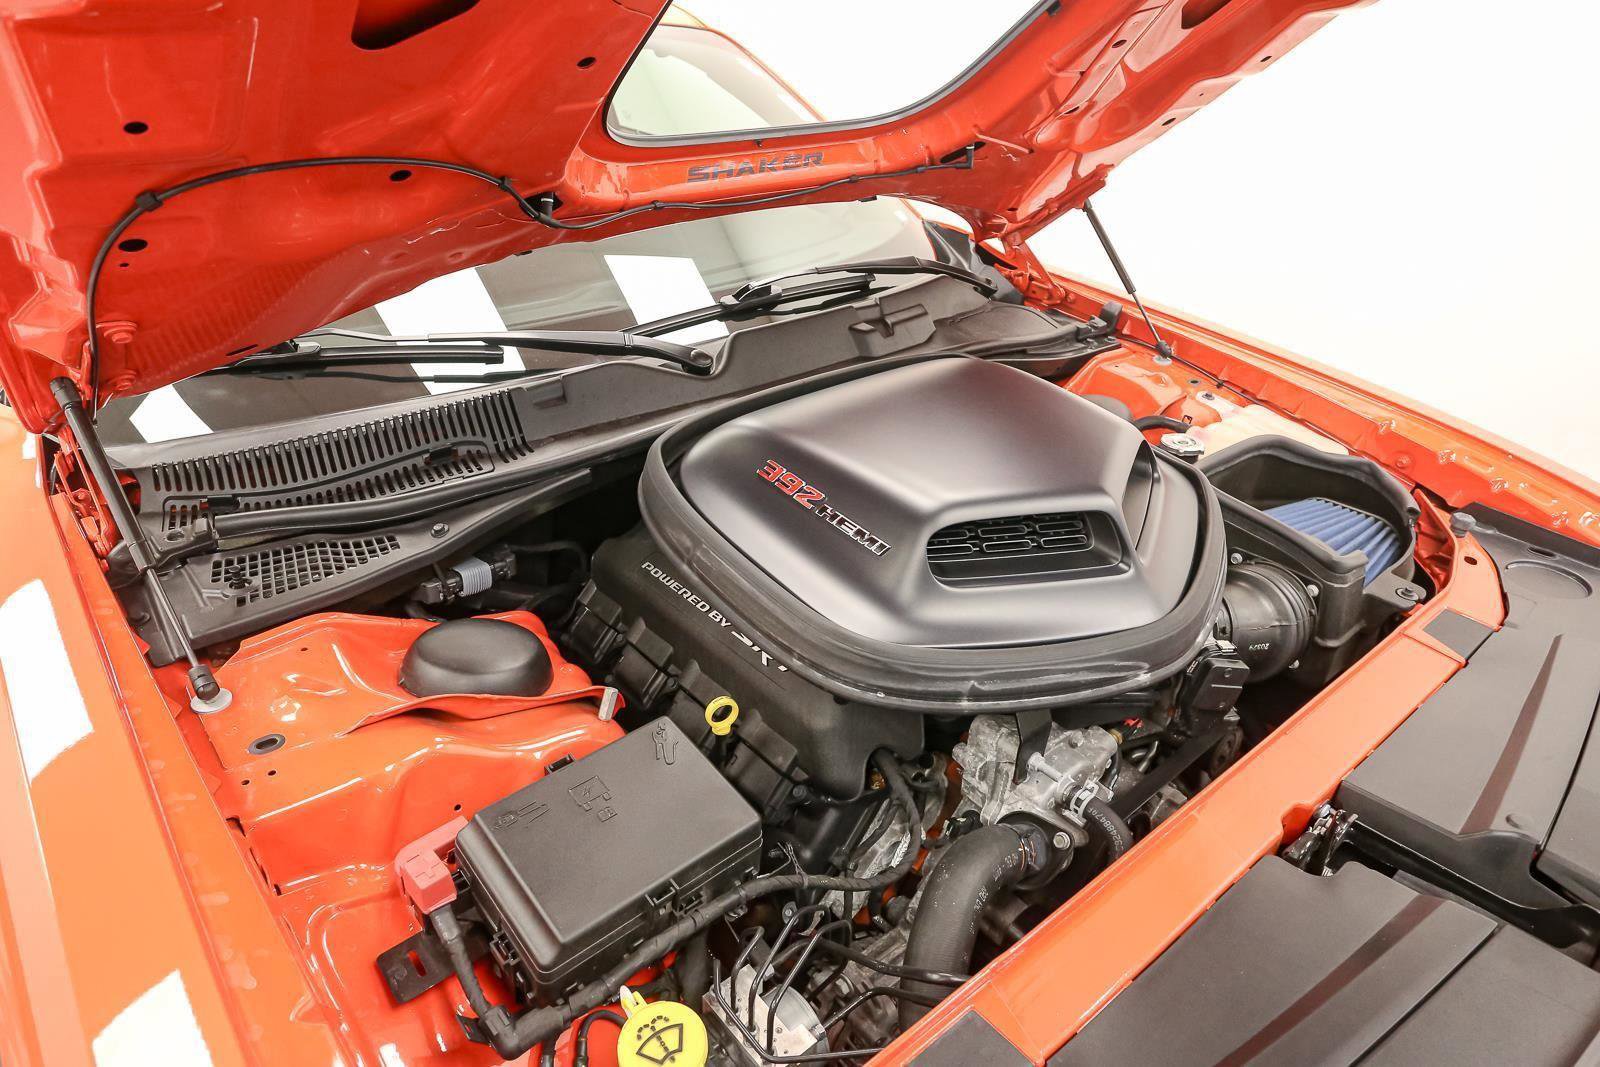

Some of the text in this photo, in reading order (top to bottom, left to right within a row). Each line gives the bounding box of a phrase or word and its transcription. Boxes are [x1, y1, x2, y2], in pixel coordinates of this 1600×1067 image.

[687, 151, 824, 183] SHAKER
[757, 459, 892, 556] 392 HEMI
[641, 561, 711, 612] POWERED
[708, 609, 732, 627] BY
